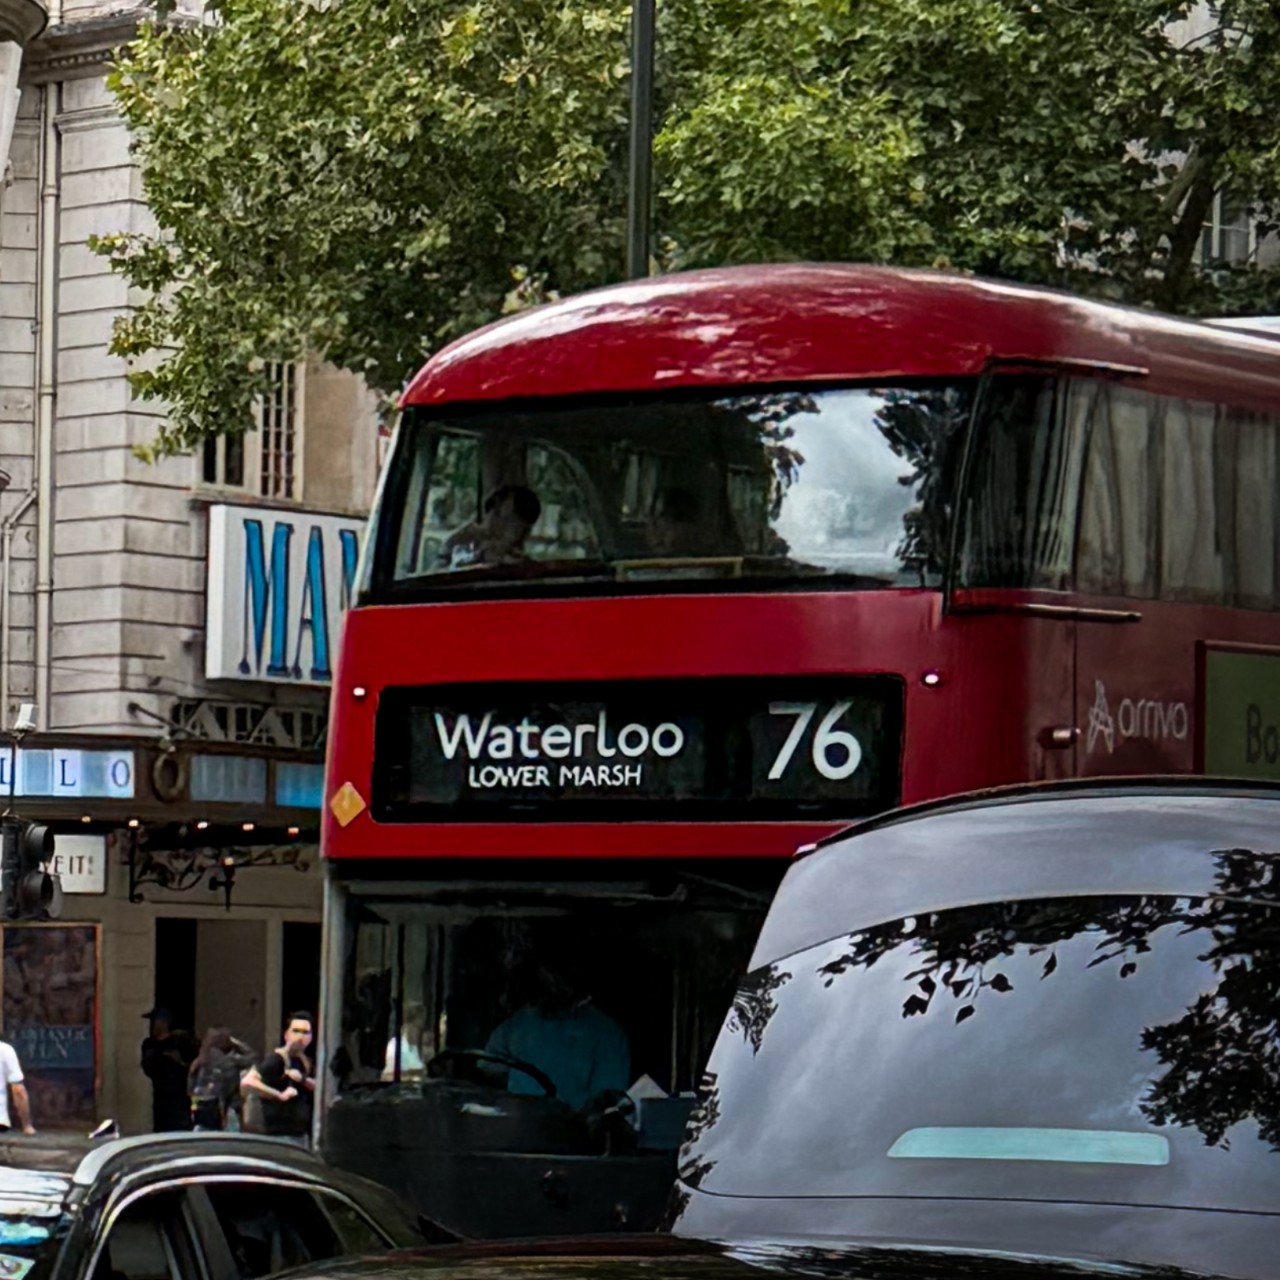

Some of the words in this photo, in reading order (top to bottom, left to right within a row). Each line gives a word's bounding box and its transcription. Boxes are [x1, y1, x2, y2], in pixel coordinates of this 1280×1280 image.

[435, 713, 684, 760] Waterloo
[767, 701, 863, 781] 76
[469, 765, 550, 788] LOWER
[559, 764, 642, 788] MARSH
